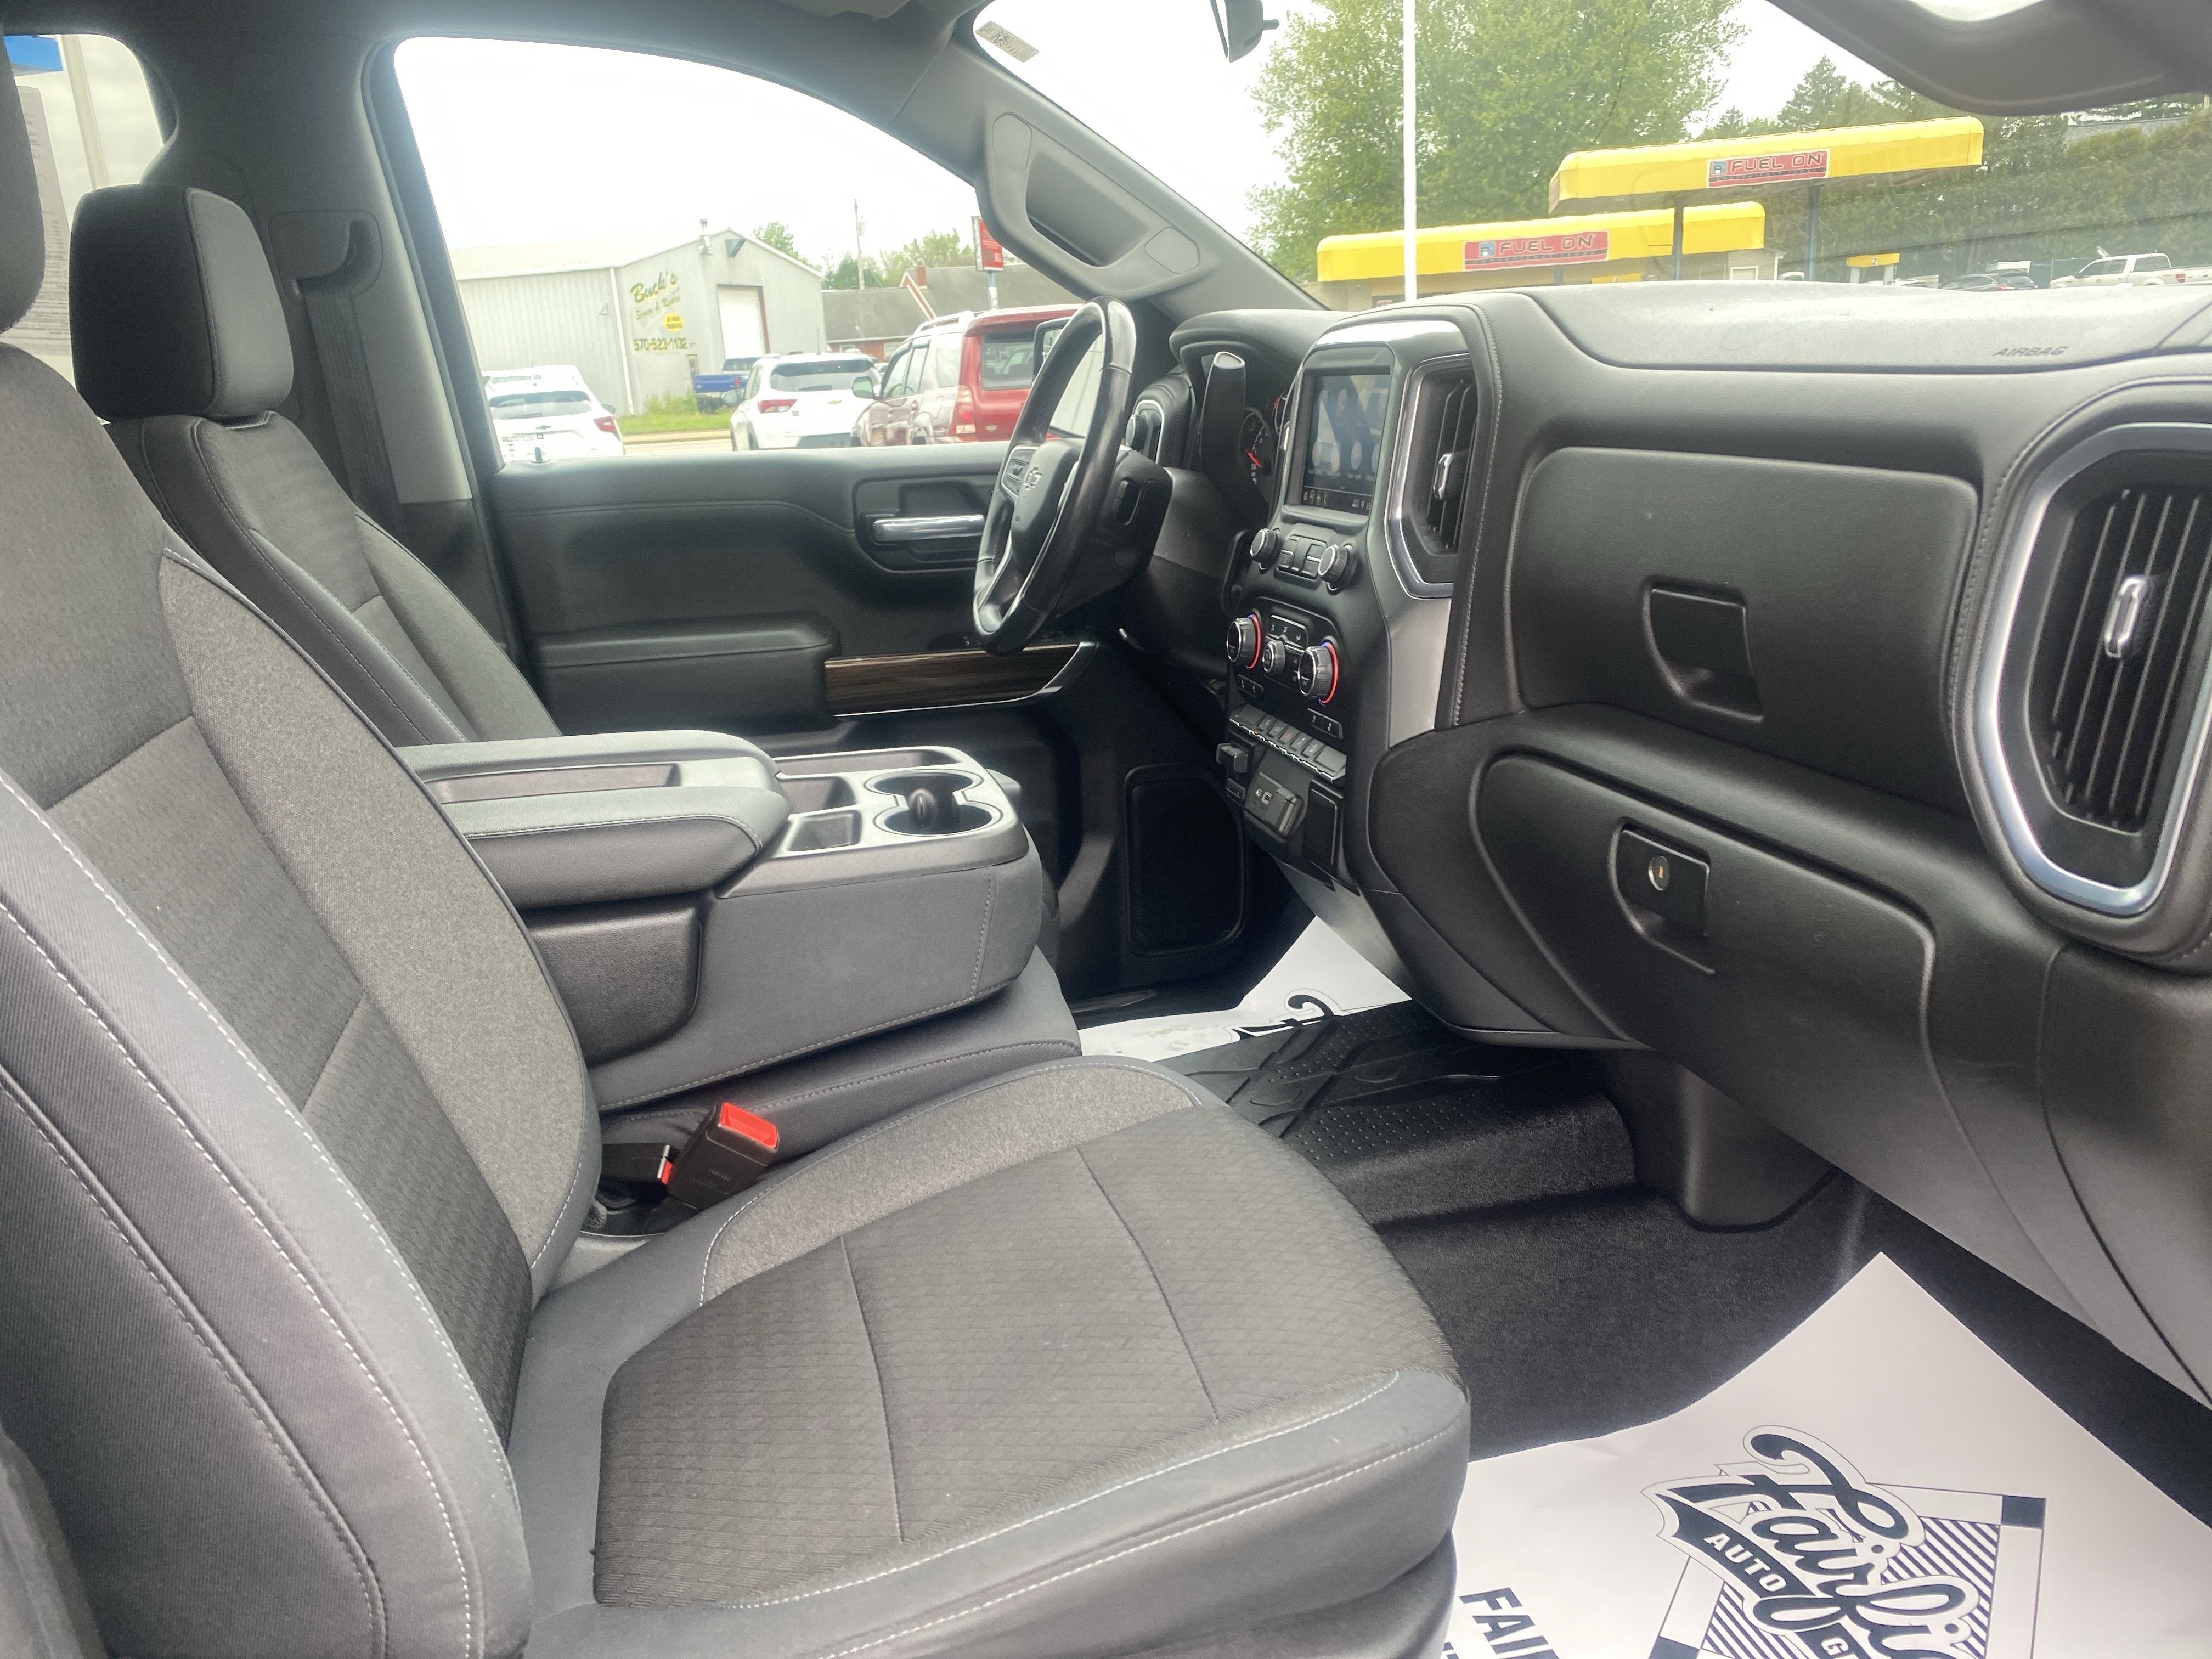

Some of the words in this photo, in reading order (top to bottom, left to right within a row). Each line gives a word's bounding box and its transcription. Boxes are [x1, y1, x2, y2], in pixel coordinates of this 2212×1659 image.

[1731, 157, 1784, 173] FUEL
[1793, 153, 1821, 166] ON
[1499, 240, 1553, 254] FUEL
[1562, 234, 1593, 250] ON
[1872, 257, 1877, 266] 2
[630, 270, 678, 303] Buck's
[1992, 346, 2069, 357] AIRBAG
[1703, 1533, 1787, 1592] AUTO
[1458, 1587, 1559, 1659] FAI
